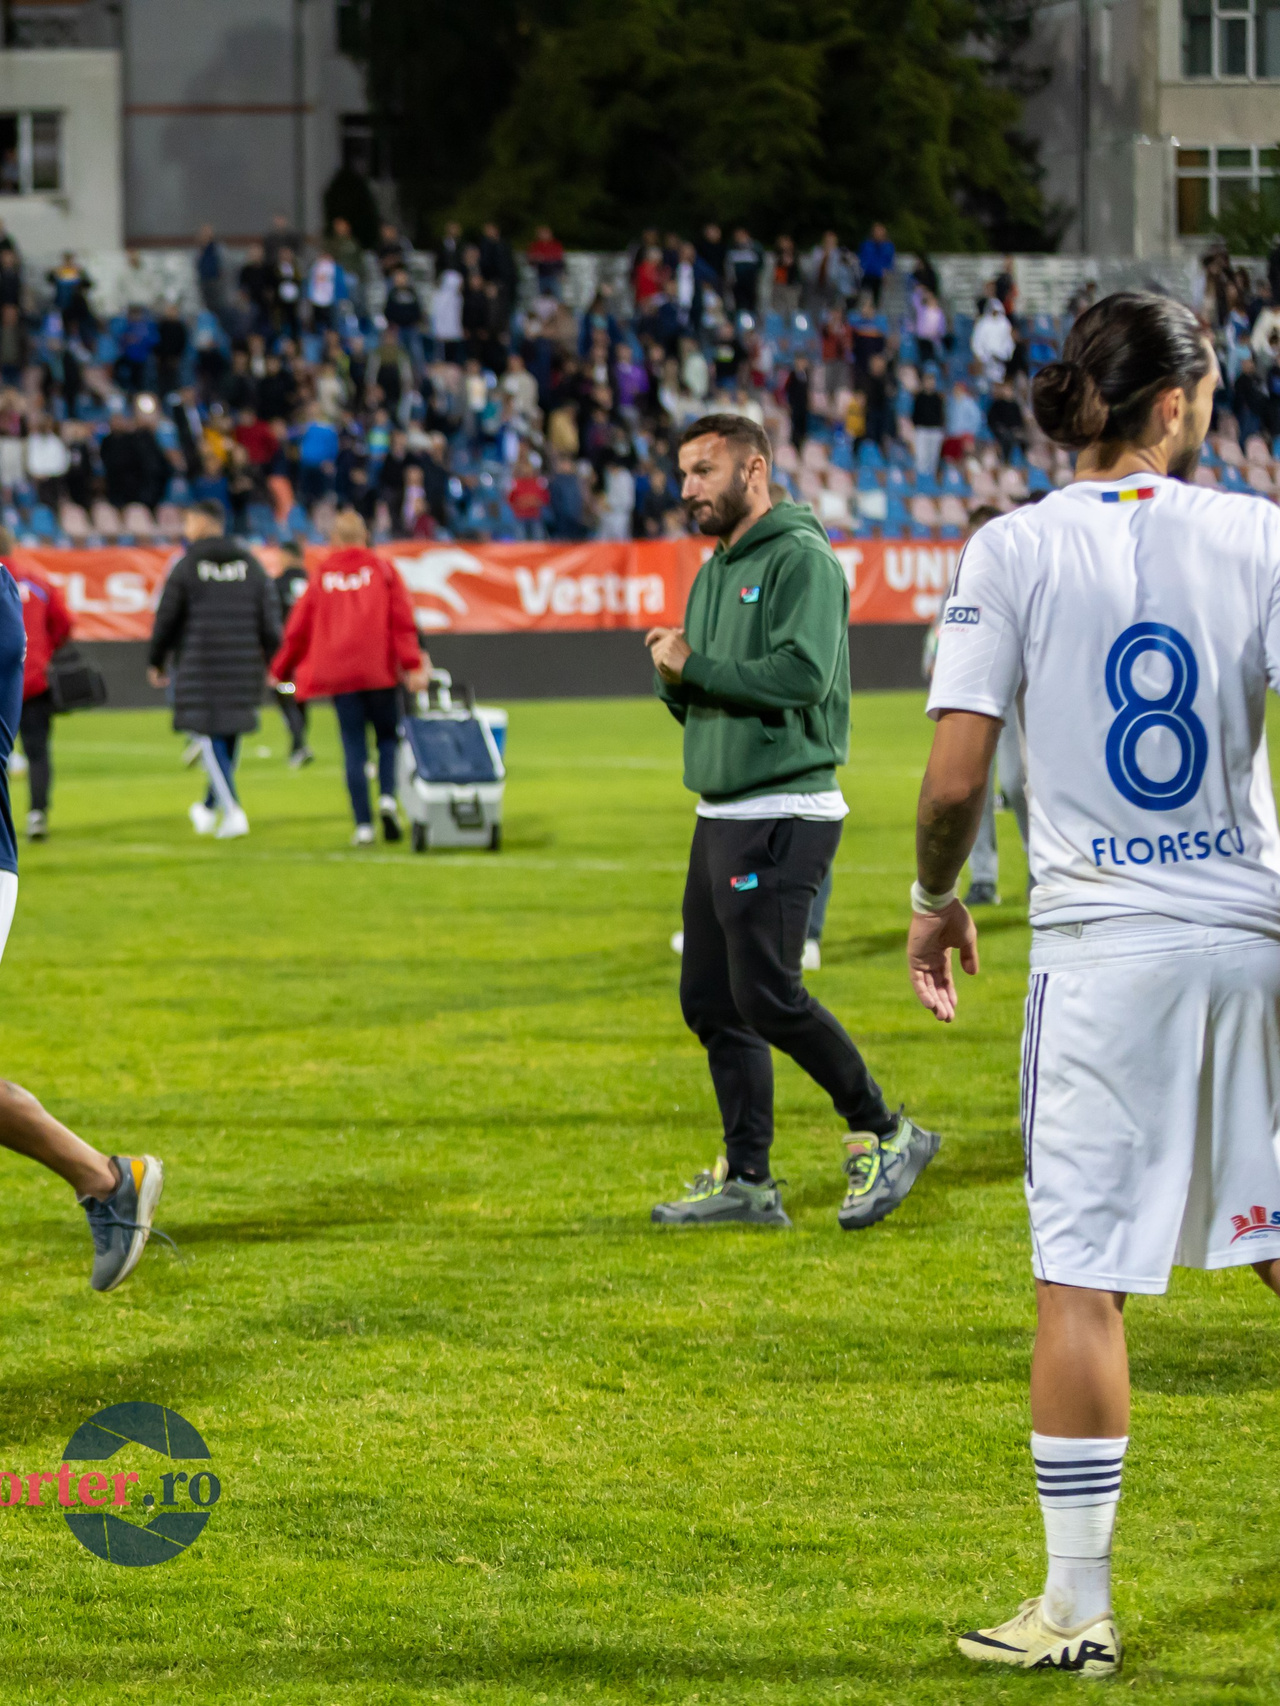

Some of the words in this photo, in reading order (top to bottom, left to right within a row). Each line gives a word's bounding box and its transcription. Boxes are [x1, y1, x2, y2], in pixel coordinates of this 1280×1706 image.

[515, 566, 667, 617] Vestra
[1105, 622, 1208, 811] 8
[1092, 826, 1245, 866] FLORESCU
